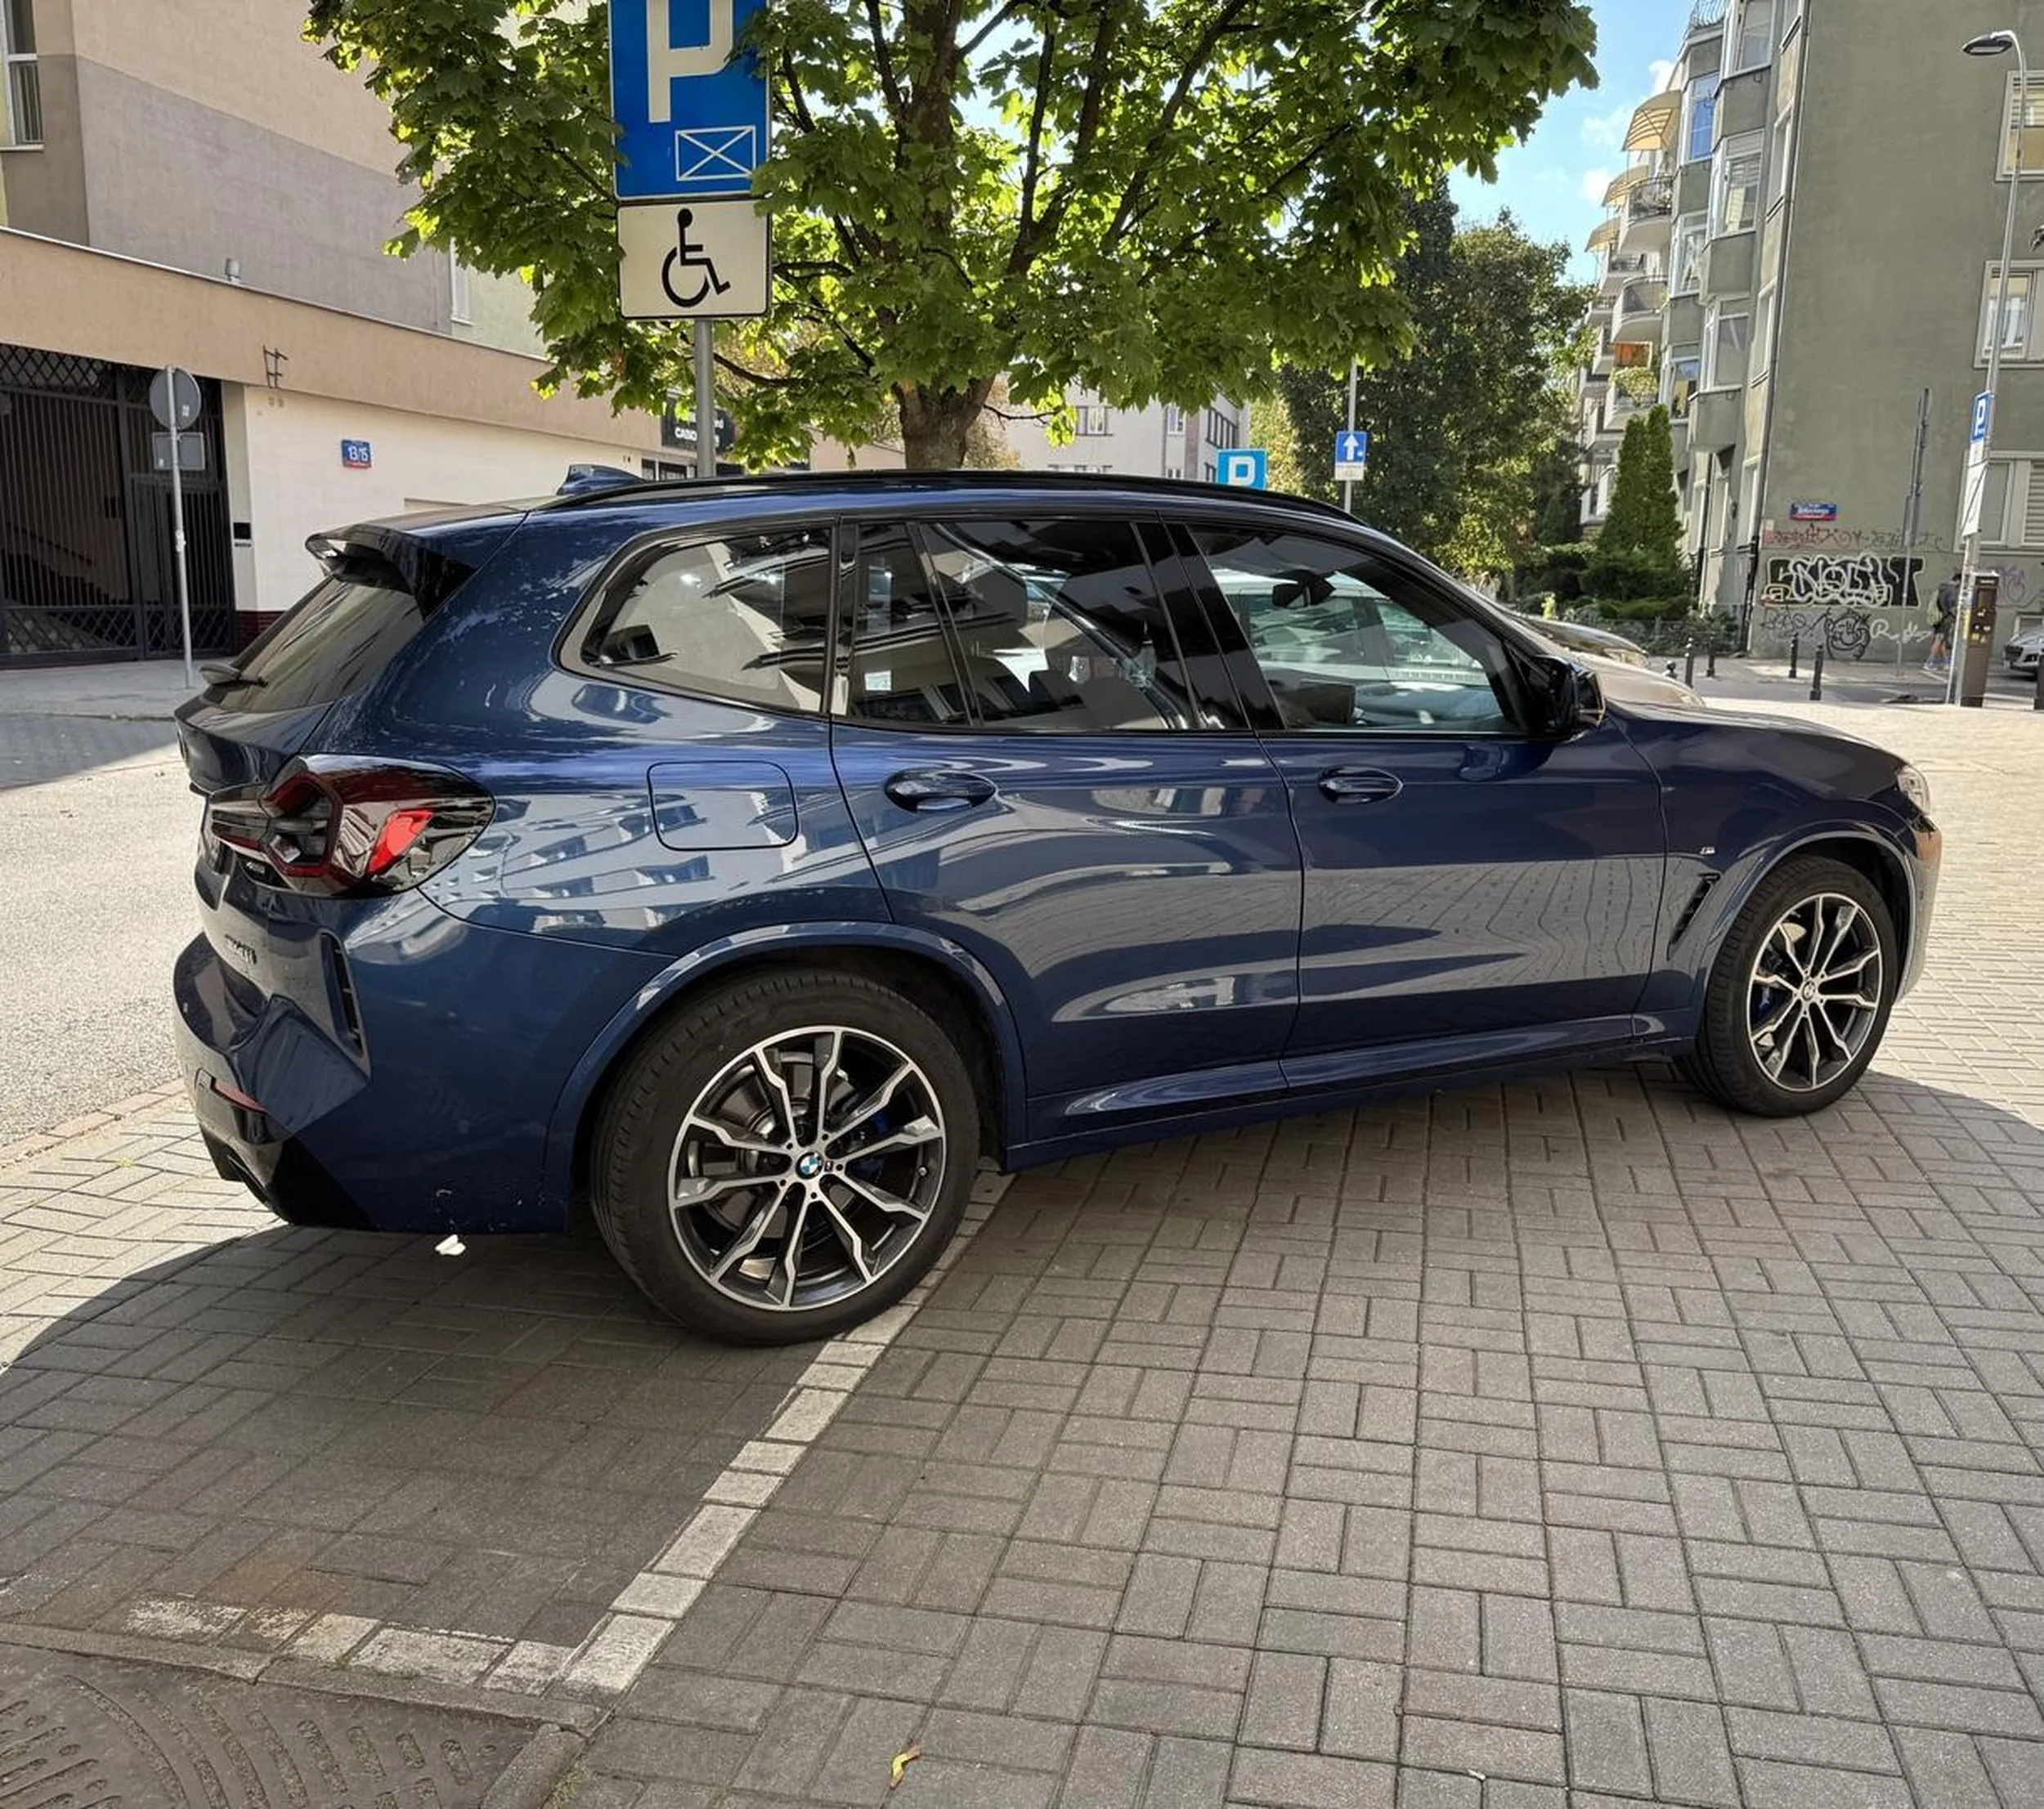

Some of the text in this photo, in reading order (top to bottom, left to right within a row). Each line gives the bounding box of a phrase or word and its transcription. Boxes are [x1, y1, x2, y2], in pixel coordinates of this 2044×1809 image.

[646, 0, 733, 123] P
[1976, 398, 1986, 435] P
[1228, 456, 1255, 486] P
